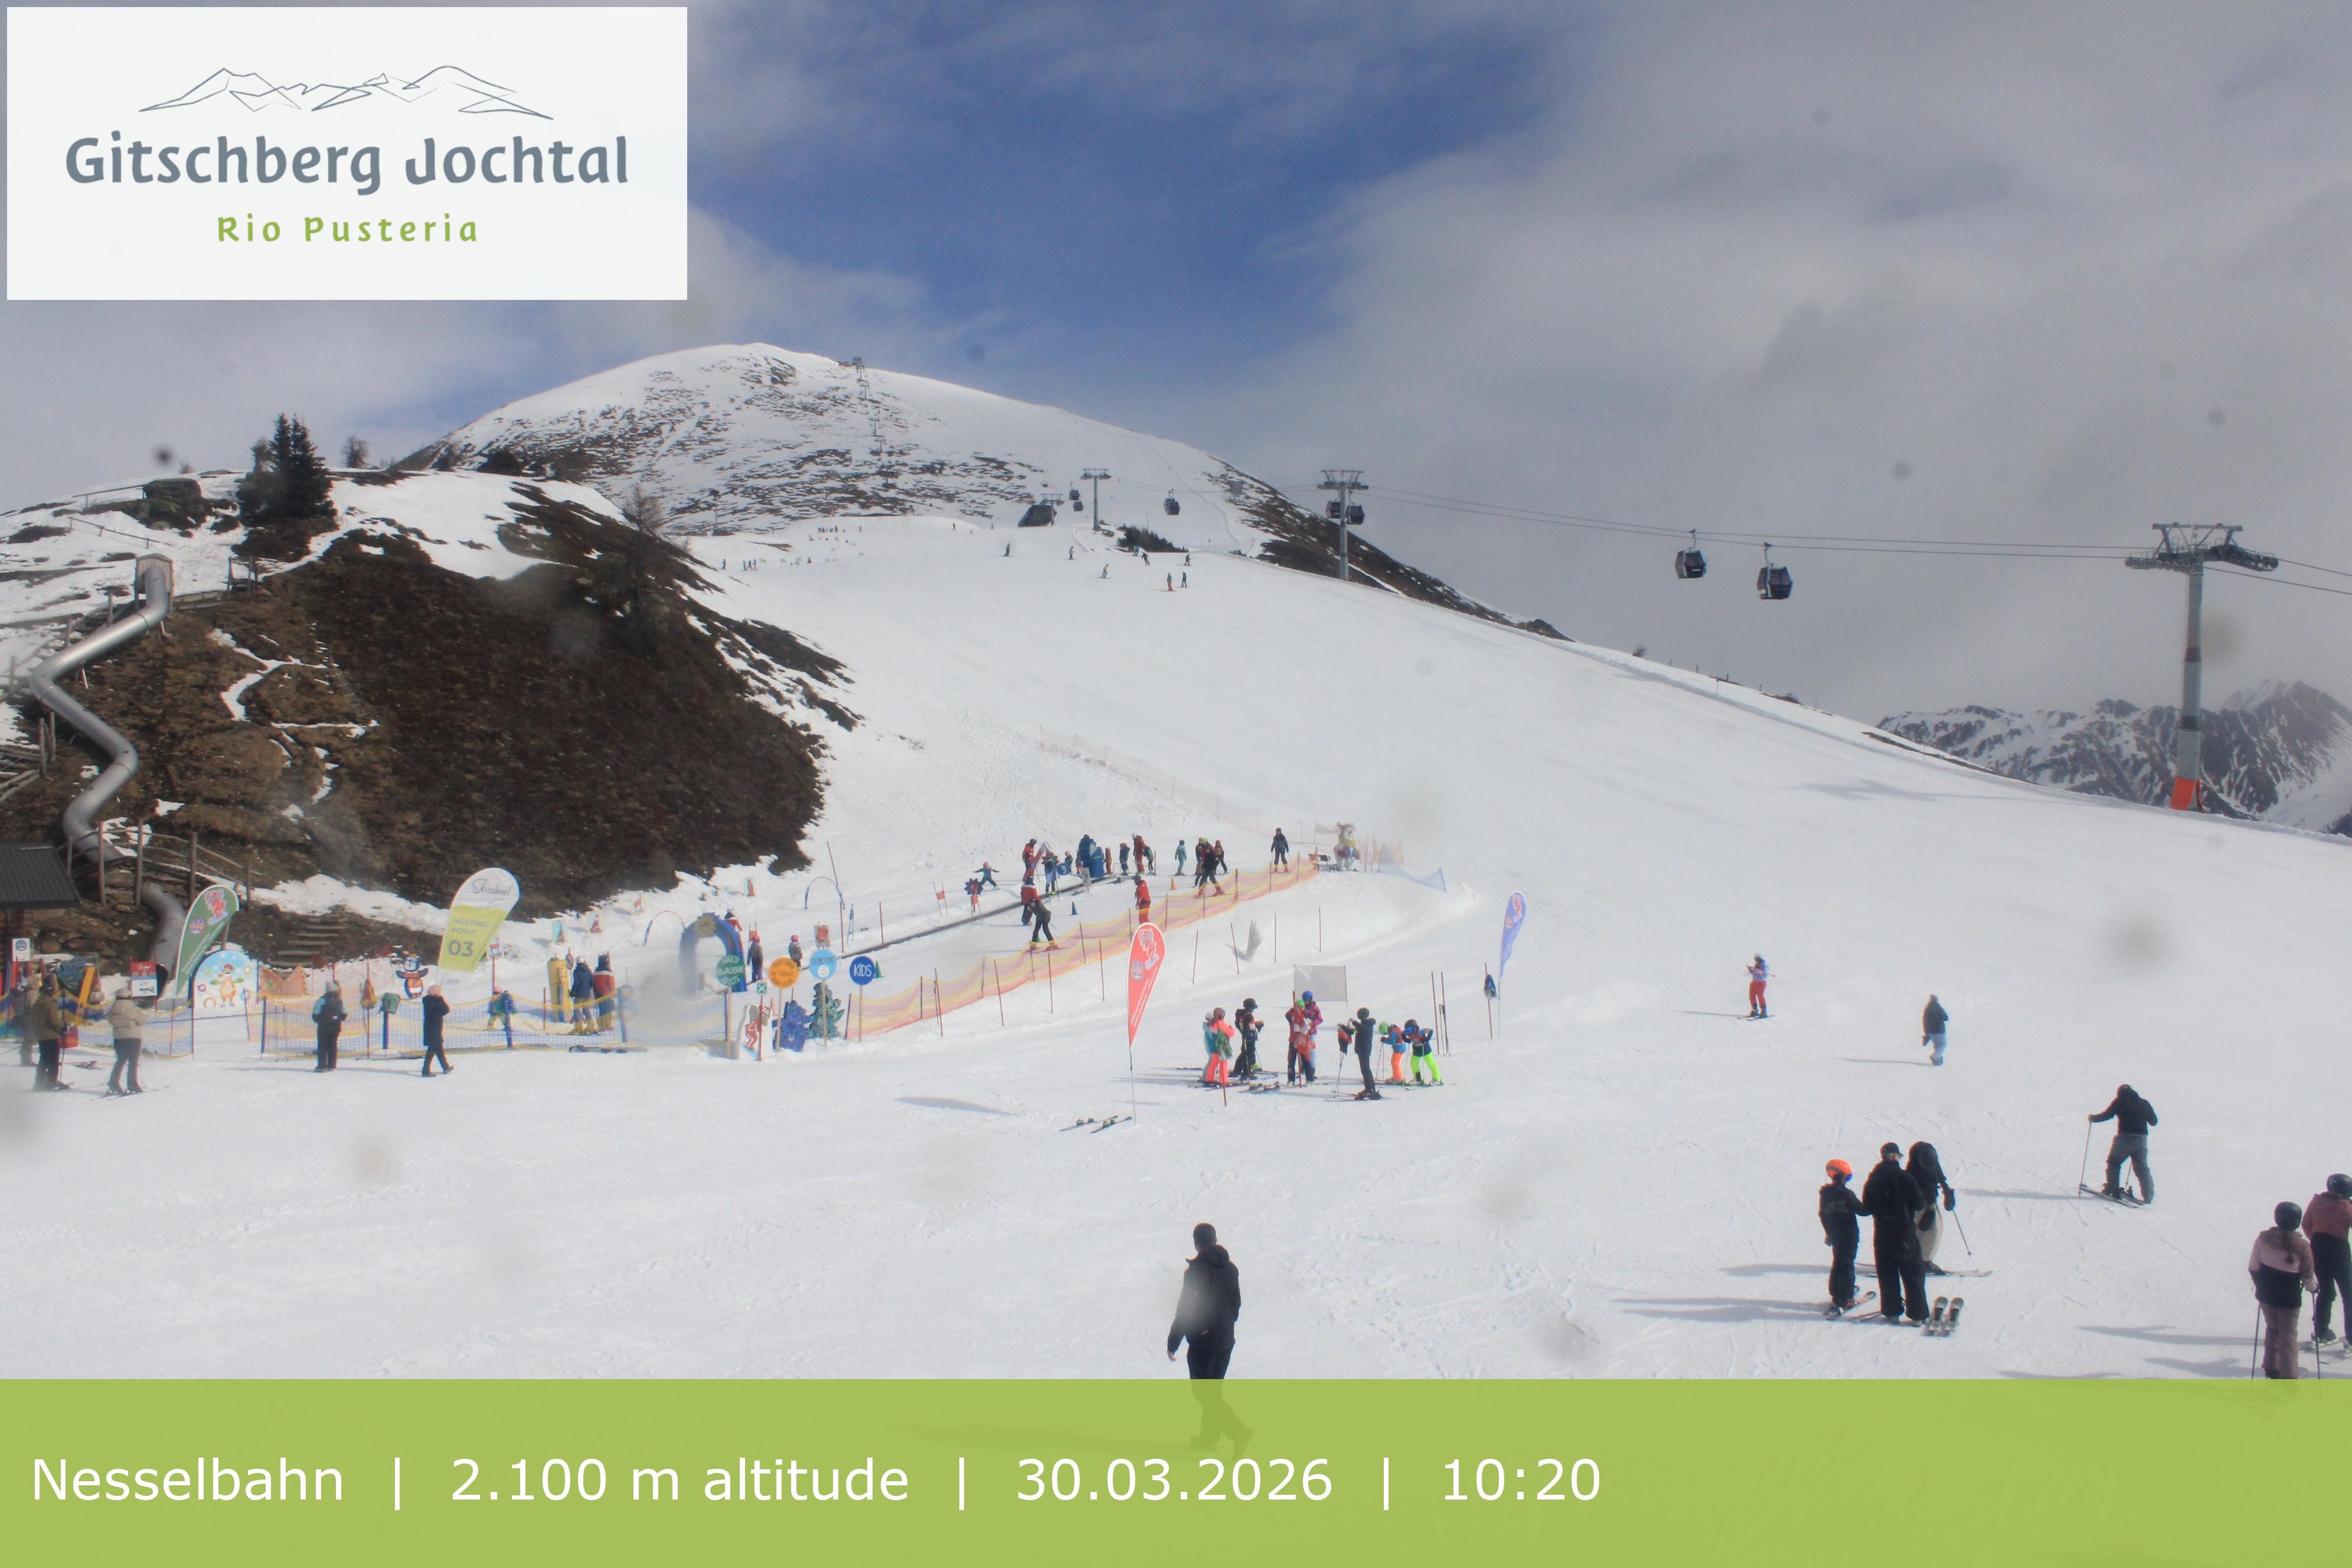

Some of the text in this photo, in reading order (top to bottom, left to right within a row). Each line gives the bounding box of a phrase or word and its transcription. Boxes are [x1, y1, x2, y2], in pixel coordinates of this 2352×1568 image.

[472, 878, 512, 896] Skischool
[453, 917, 488, 927] MEETING
[452, 927, 476, 936] POINT
[448, 940, 474, 956] 03
[854, 963, 872, 977] KIDS
